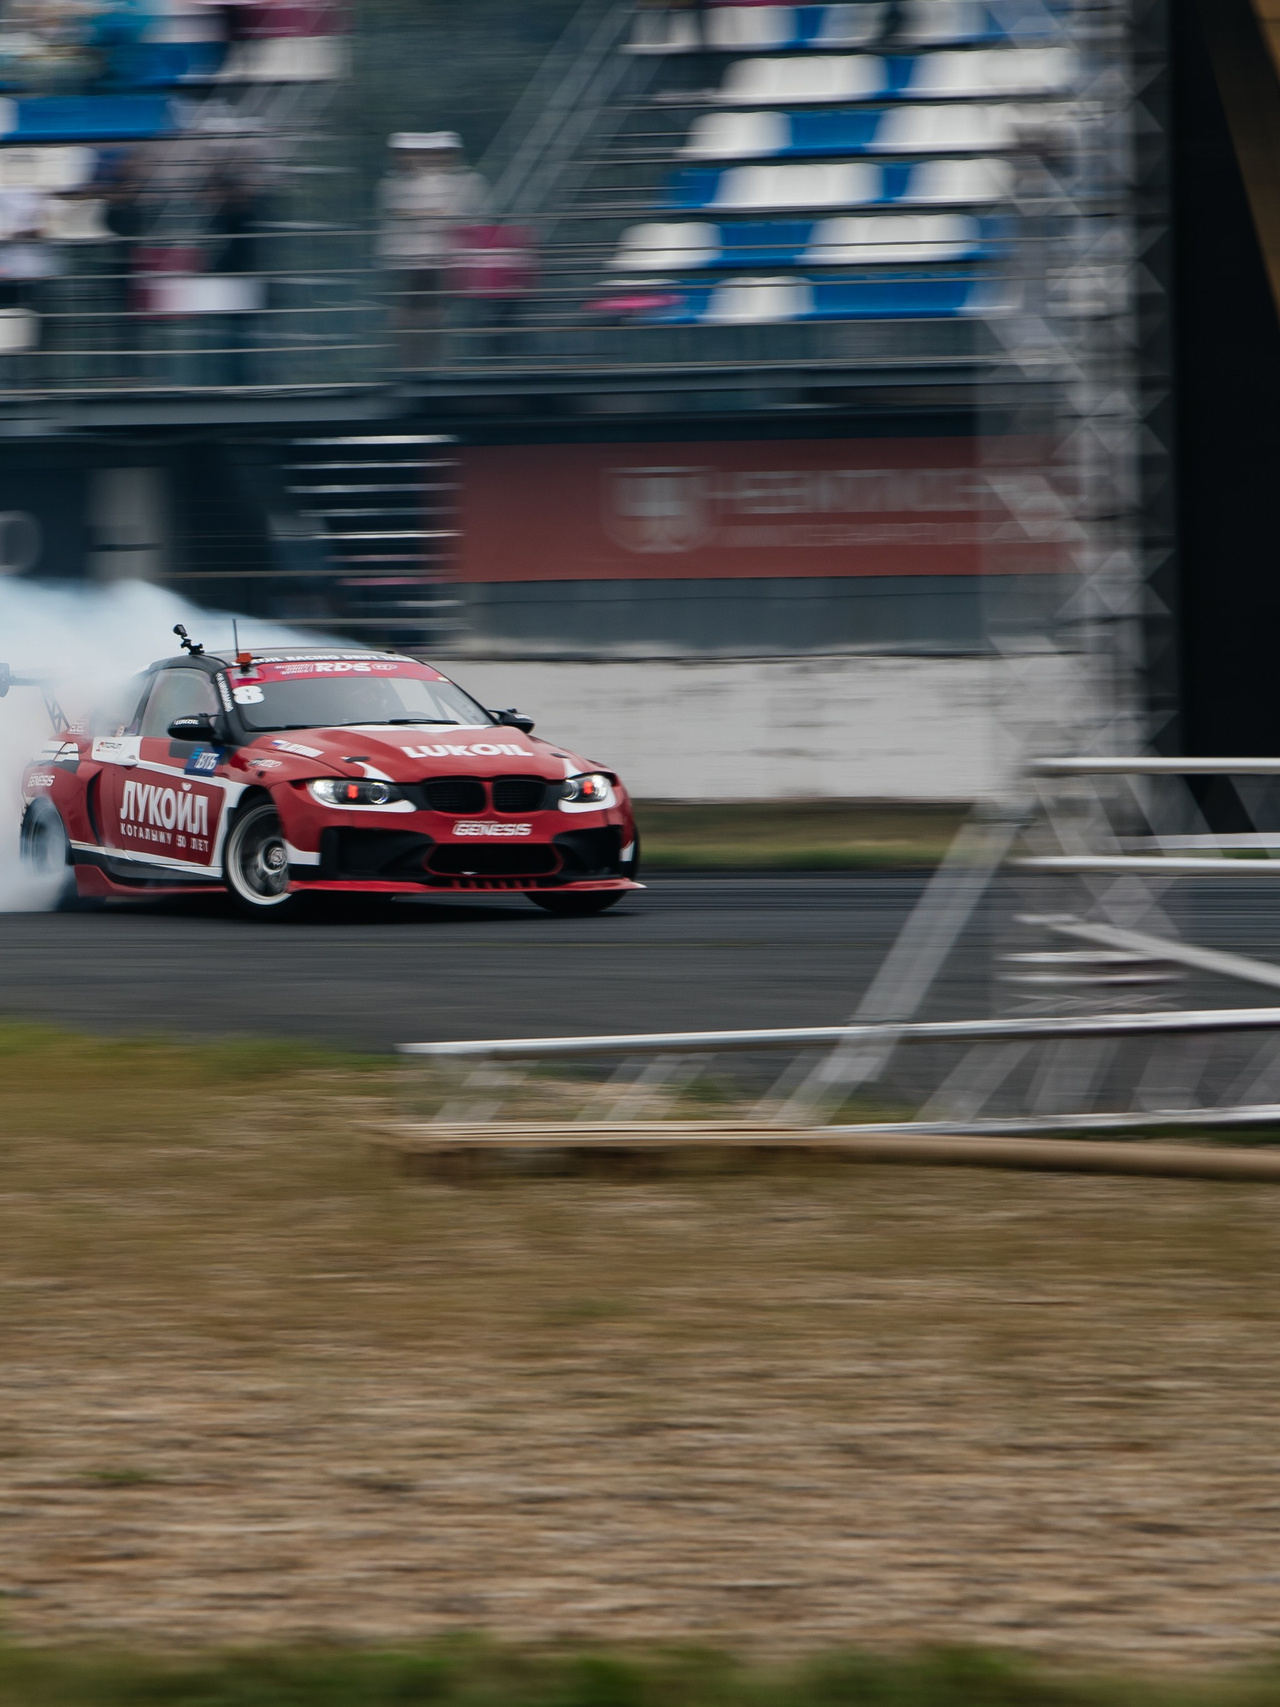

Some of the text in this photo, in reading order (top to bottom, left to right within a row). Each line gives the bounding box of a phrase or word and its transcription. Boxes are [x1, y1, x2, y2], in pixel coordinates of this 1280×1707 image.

[315, 662, 371, 672] RDS
[233, 685, 265, 704] 8
[400, 743, 534, 758] LUKOIL
[195, 752, 219, 770] ВТБ
[120, 780, 209, 836] ЛУКОЙЛ
[120, 823, 172, 845] КОГАЛЫМУ
[452, 823, 533, 836] GENESIS
